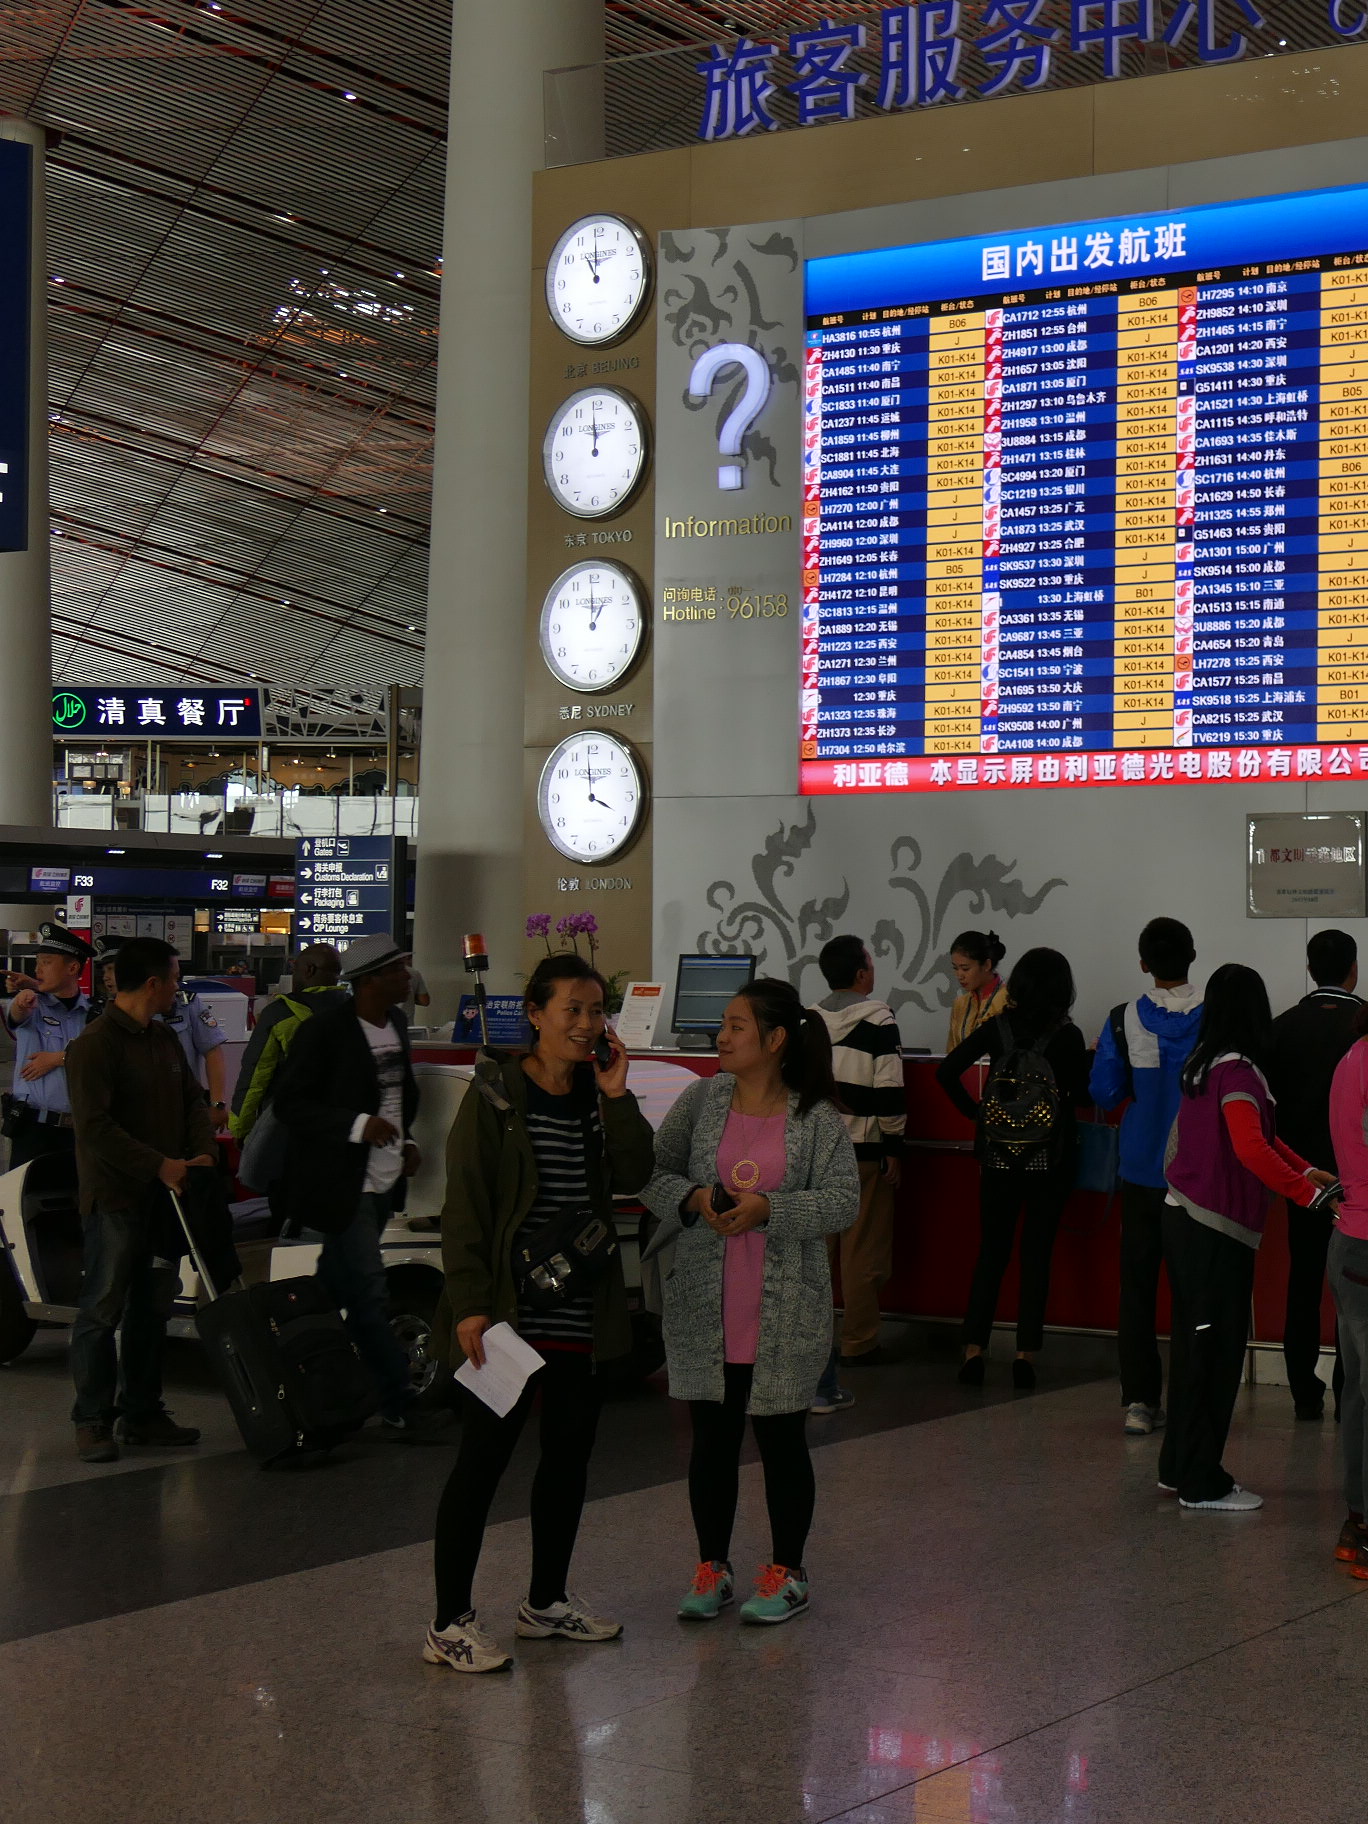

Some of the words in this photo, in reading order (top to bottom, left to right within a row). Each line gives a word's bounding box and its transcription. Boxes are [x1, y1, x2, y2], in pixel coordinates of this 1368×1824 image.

[580, 248, 616, 260] LONGINES
[982, 222, 1187, 281] 国内出发航班
[1002, 312, 1038, 323] CA1712
[1041, 308, 1063, 318] 12:55
[1139, 296, 1157, 306] B06
[822, 332, 856, 344] HA3816
[858, 328, 880, 339] 10:55
[948, 318, 966, 328] B06
[1196, 344, 1234, 356] CA1201
[1238, 340, 1263, 350] 14:20
[1265, 337, 1287, 349] 西安
[591, 357, 640, 374] BEIJING
[579, 422, 616, 434] LONGINES
[665, 513, 791, 538] Information
[564, 533, 587, 547] 东京
[591, 529, 633, 545] TOKYO
[576, 596, 612, 605] LONGINES
[663, 587, 716, 602] 问询电话
[663, 606, 716, 621] Hotline
[727, 594, 788, 619] 96158
[97, 697, 245, 726] 清真餐厅
[559, 706, 581, 720] 悉尼
[587, 705, 634, 718] SYDNEY
[575, 768, 611, 776] LONGINES
[833, 761, 908, 787] 利亚德
[314, 848, 333, 856] Gates
[315, 863, 342, 872] 海关申报
[75, 876, 93, 886] F33
[315, 873, 340, 881] Customs
[341, 873, 373, 881] Declaration
[557, 877, 580, 891] 伦敦
[585, 878, 632, 890] LONDON
[212, 880, 228, 890] F32
[314, 888, 342, 897] 行李打包
[314, 899, 344, 908] Packaging
[325, 925, 348, 933] Lounge
